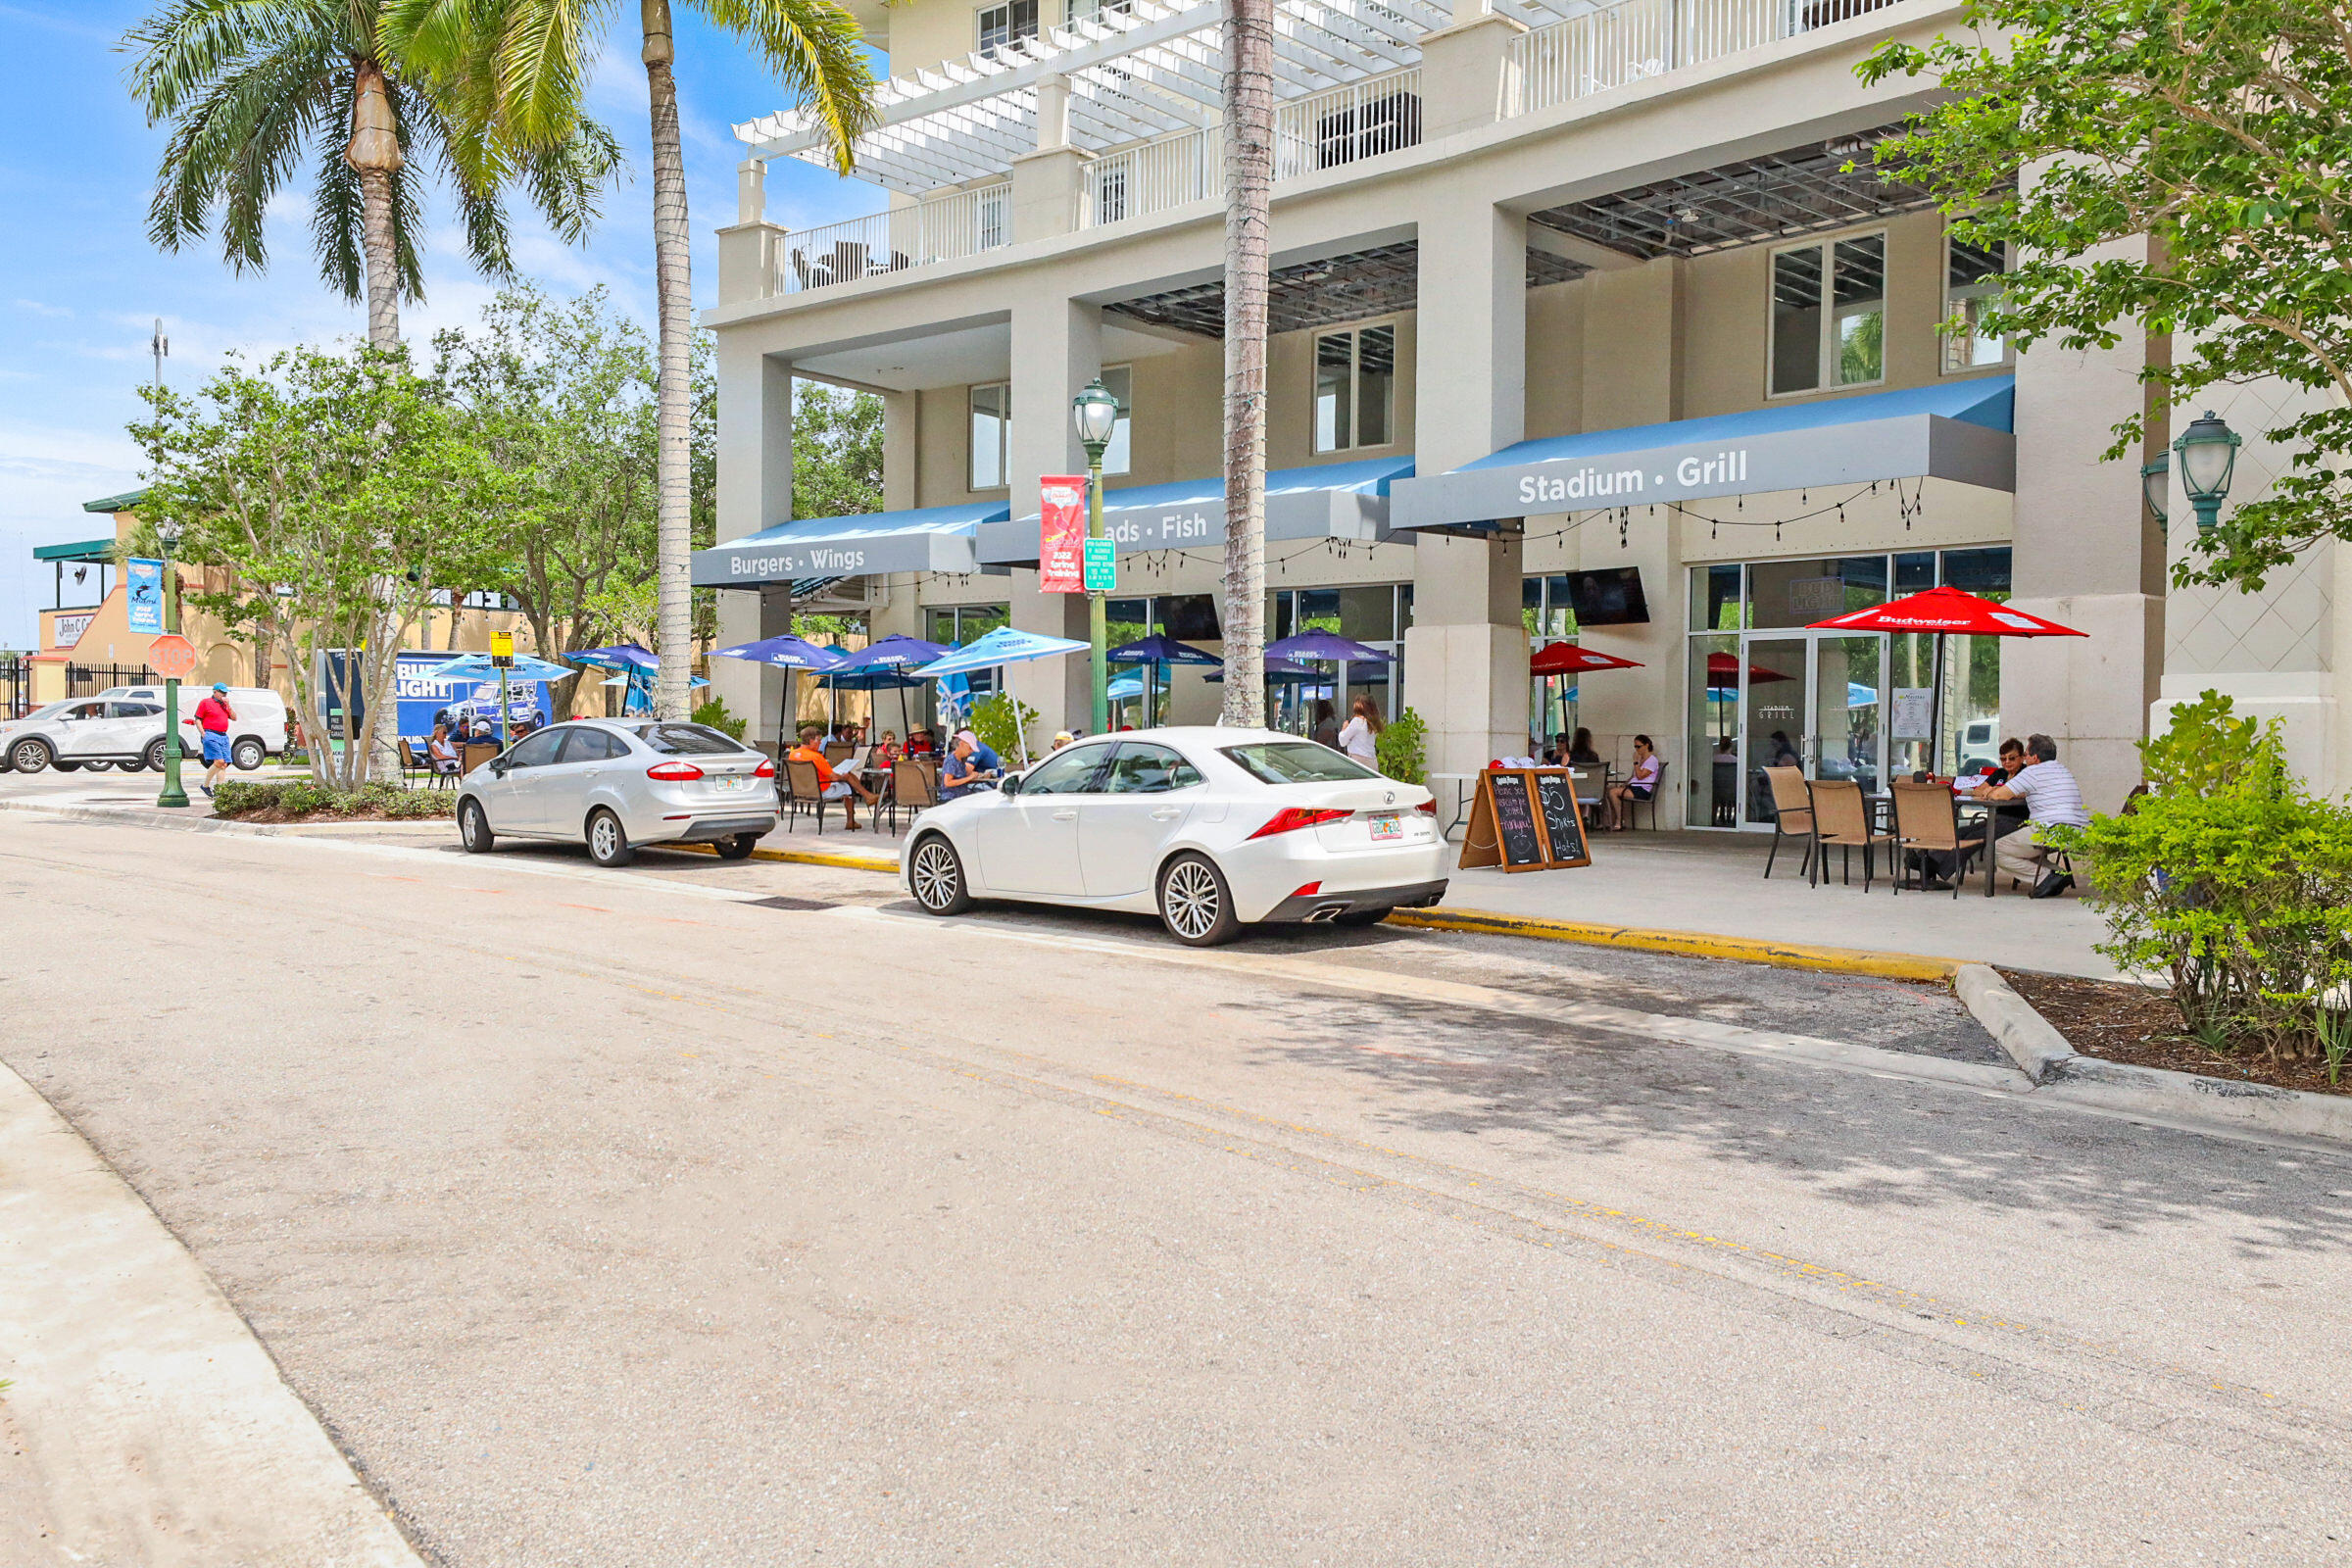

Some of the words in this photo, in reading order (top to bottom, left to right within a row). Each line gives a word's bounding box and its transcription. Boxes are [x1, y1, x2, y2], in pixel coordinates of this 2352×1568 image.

[1519, 467, 1643, 504] Stadium
[1677, 450, 1747, 487] Grill
[1162, 513, 1206, 539] Fish
[731, 556, 793, 576] Burgers
[810, 549, 863, 570] Wings
[1051, 560, 1075, 569] Spring
[1047, 568, 1080, 578] Training
[59, 619, 74, 637] John
[75, 618, 80, 632] C
[1877, 615, 1971, 626] Budweiser
[151, 649, 194, 665] STOP
[1759, 710, 1794, 719] GRILL
[1539, 786, 1565, 810] $5
